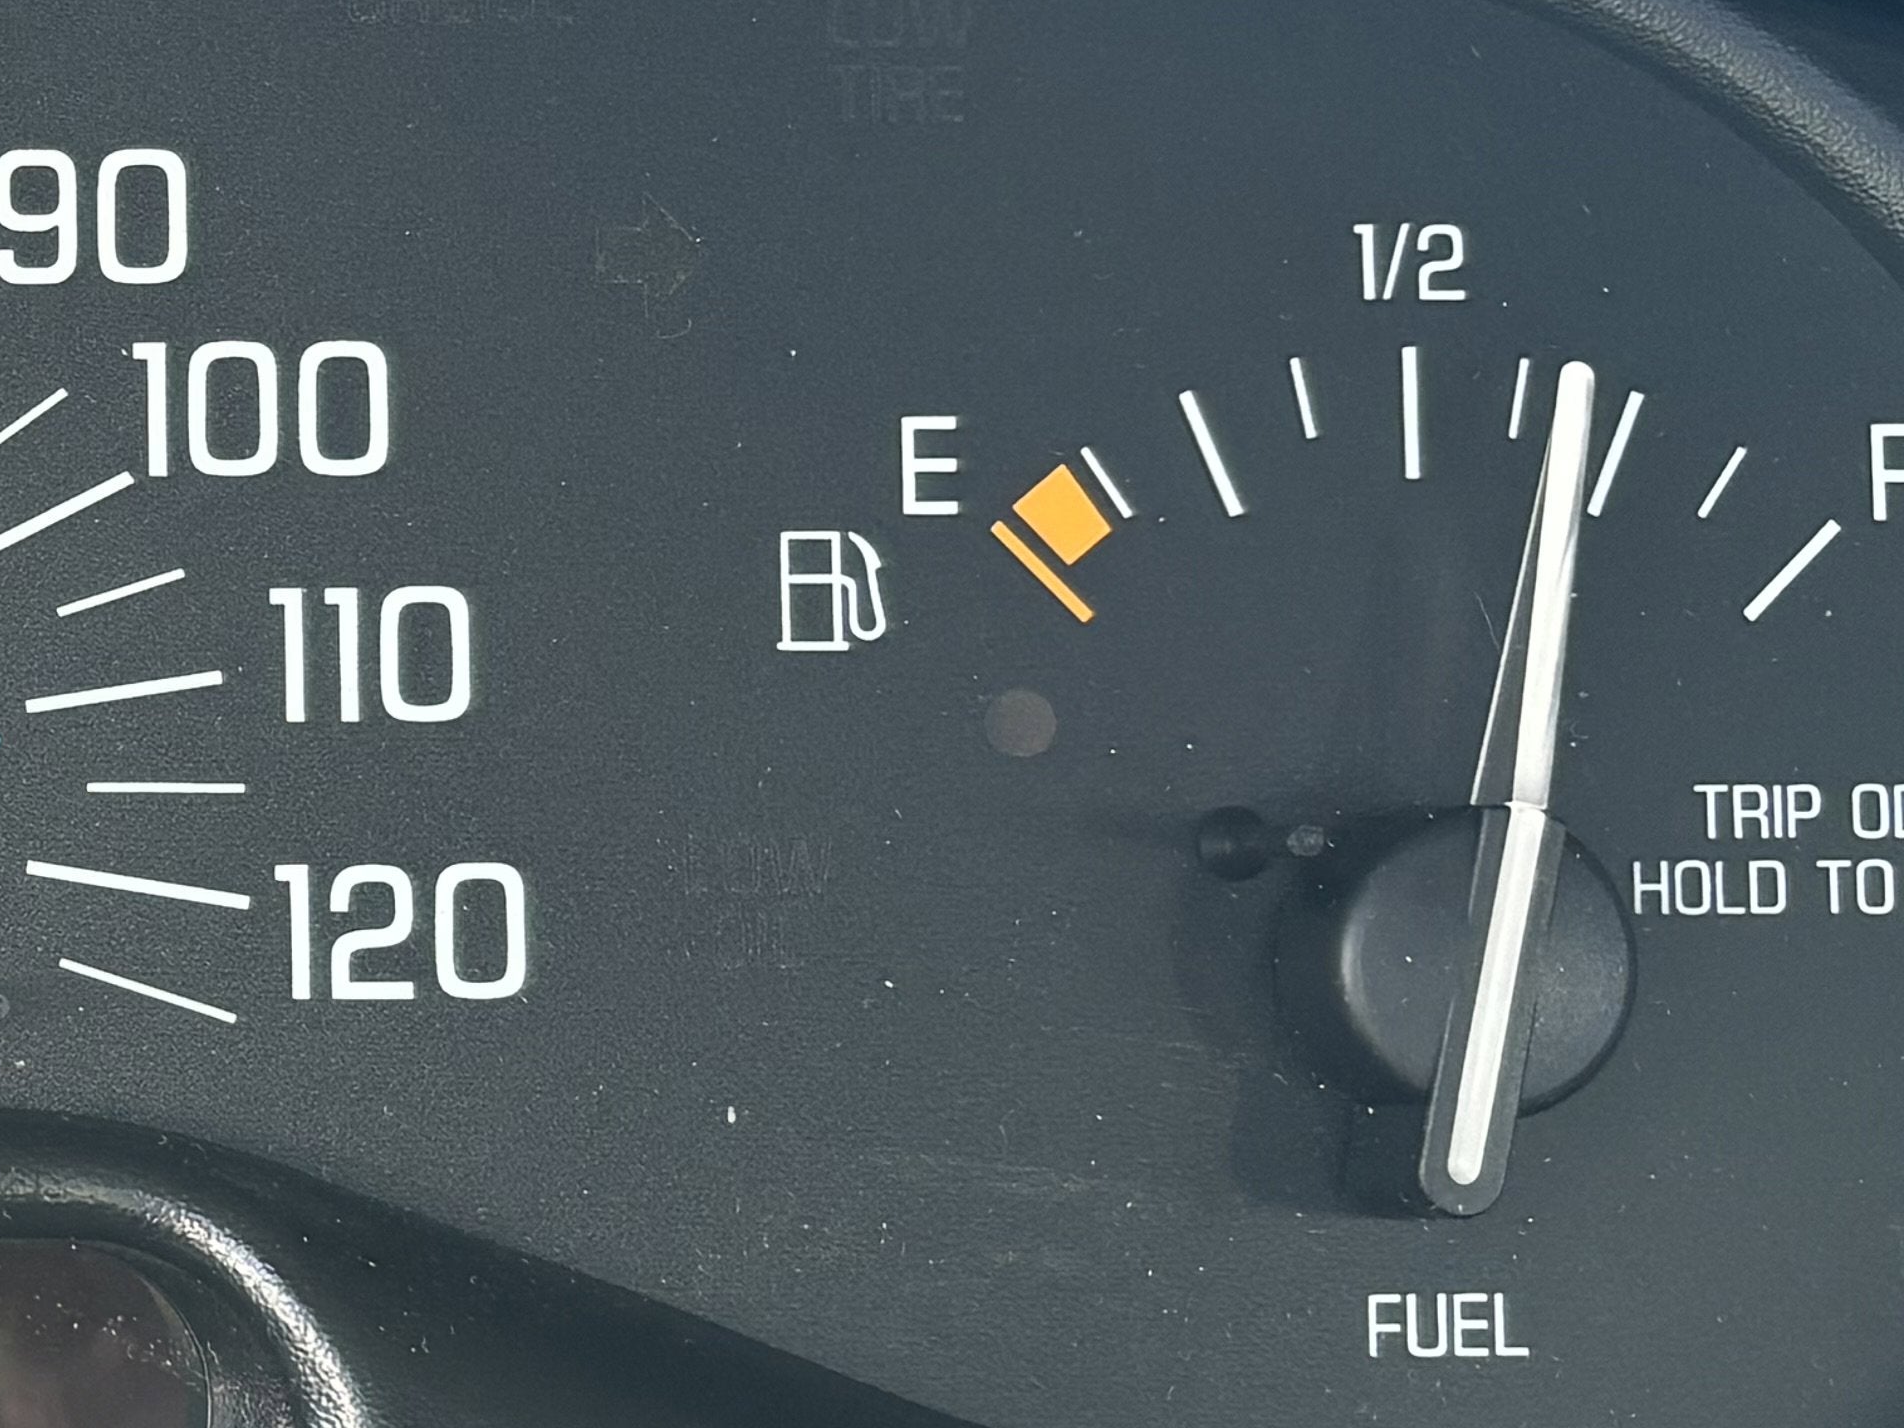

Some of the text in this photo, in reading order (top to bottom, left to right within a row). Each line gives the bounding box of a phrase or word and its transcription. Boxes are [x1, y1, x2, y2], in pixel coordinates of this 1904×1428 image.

[1354, 223, 1466, 300] 1/2
[132, 340, 389, 477] 100
[902, 416, 959, 514] E
[1871, 424, 1904, 520] F
[270, 586, 471, 722] 110
[1694, 784, 1822, 840] TRIP
[275, 863, 526, 999] 120
[1634, 859, 1895, 915] HOLD TO
[1368, 1293, 1529, 1357] FUEL
